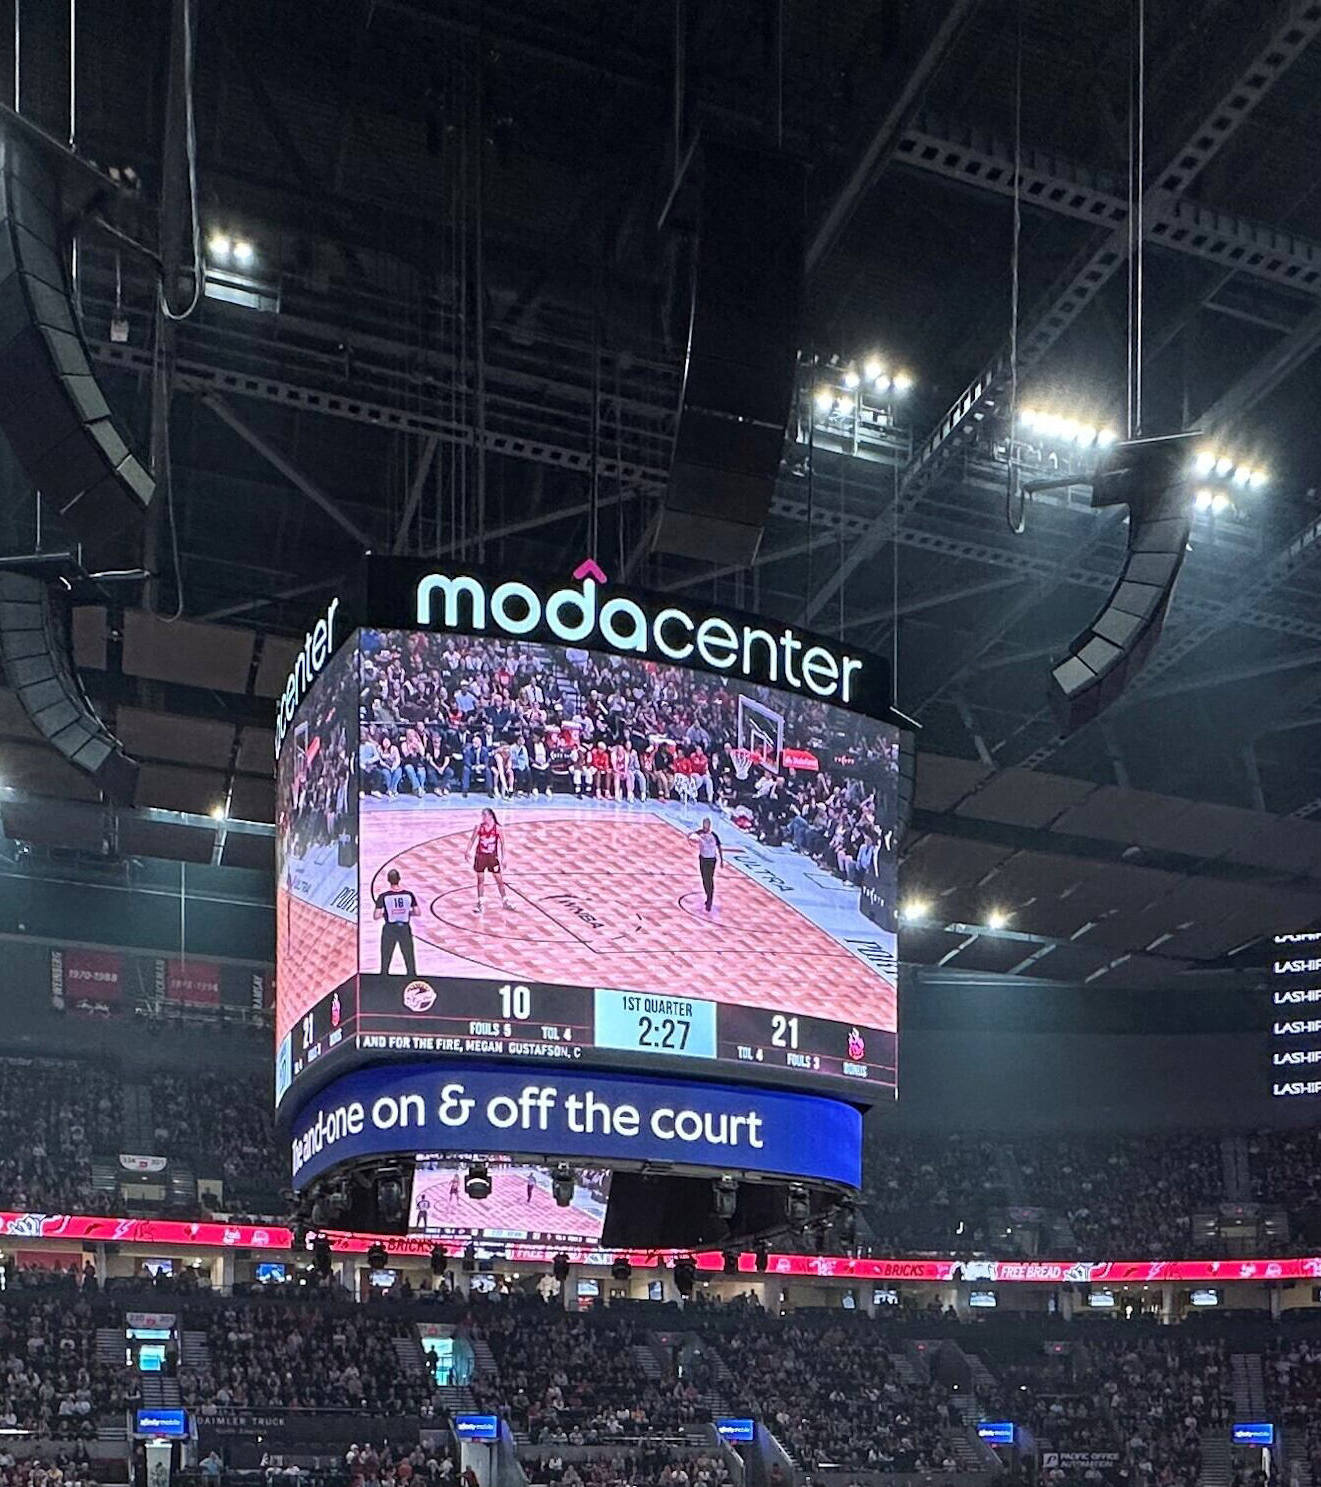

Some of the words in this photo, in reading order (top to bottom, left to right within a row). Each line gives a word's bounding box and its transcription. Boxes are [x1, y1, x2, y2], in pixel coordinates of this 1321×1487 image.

[498, 984, 531, 1020] 10
[622, 996, 642, 1011] 1ST
[644, 998, 693, 1016] QUARTER
[469, 1022, 500, 1037] FOULS
[563, 1027, 572, 1041] 4
[638, 1015, 692, 1050] 2:27
[770, 1014, 799, 1049] 21
[363, 1036, 386, 1049] AND
[389, 1036, 410, 1049] FOR
[413, 1037, 434, 1050] THE
[436, 1037, 463, 1053] FIRE,
[466, 1040, 503, 1054] MEGAN
[756, 1047, 764, 1062] 4
[786, 1052, 811, 1068] FOULS
[303, 1101, 365, 1163] and-one
[372, 1094, 426, 1130] on
[438, 1083, 476, 1127] &
[486, 1085, 554, 1128] off
[566, 1092, 640, 1137] the
[651, 1104, 764, 1150] court
[884, 1264, 925, 1278] BRICKS
[1001, 1265, 1026, 1279] FREE
[1026, 1265, 1062, 1280] BREAD
